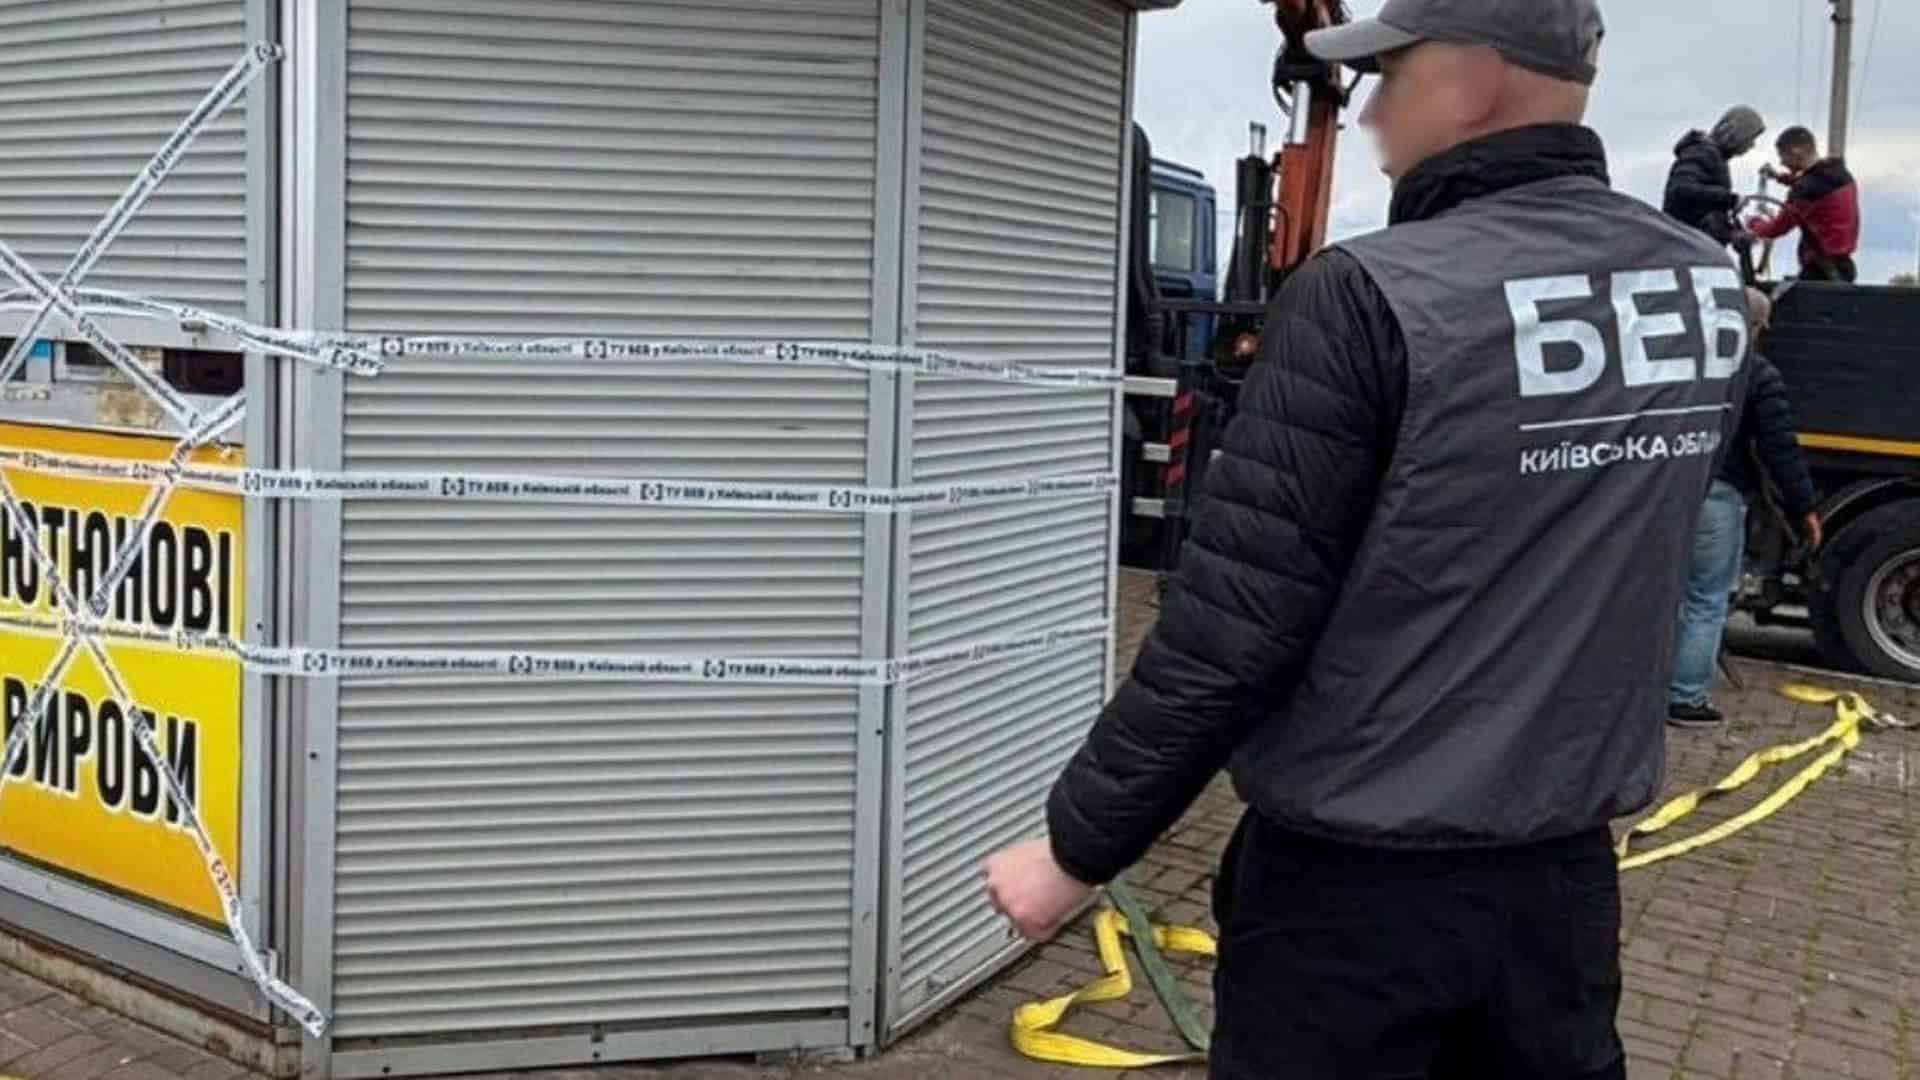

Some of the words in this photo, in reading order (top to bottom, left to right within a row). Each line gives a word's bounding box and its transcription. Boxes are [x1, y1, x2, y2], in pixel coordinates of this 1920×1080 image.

[1503, 266, 1747, 397] БЕБ
[1520, 434, 1670, 474] КИЇВСЬКА
[263, 477, 277, 488] ТУ
[280, 477, 301, 488] БЕБ
[468, 481, 483, 491] ТУ
[486, 482, 509, 492] БЕБ
[667, 487, 681, 497] ТУ
[331, 656, 346, 667] ТУ
[350, 656, 373, 667] БЕБ
[4, 677, 196, 825] ВИРОБИ
